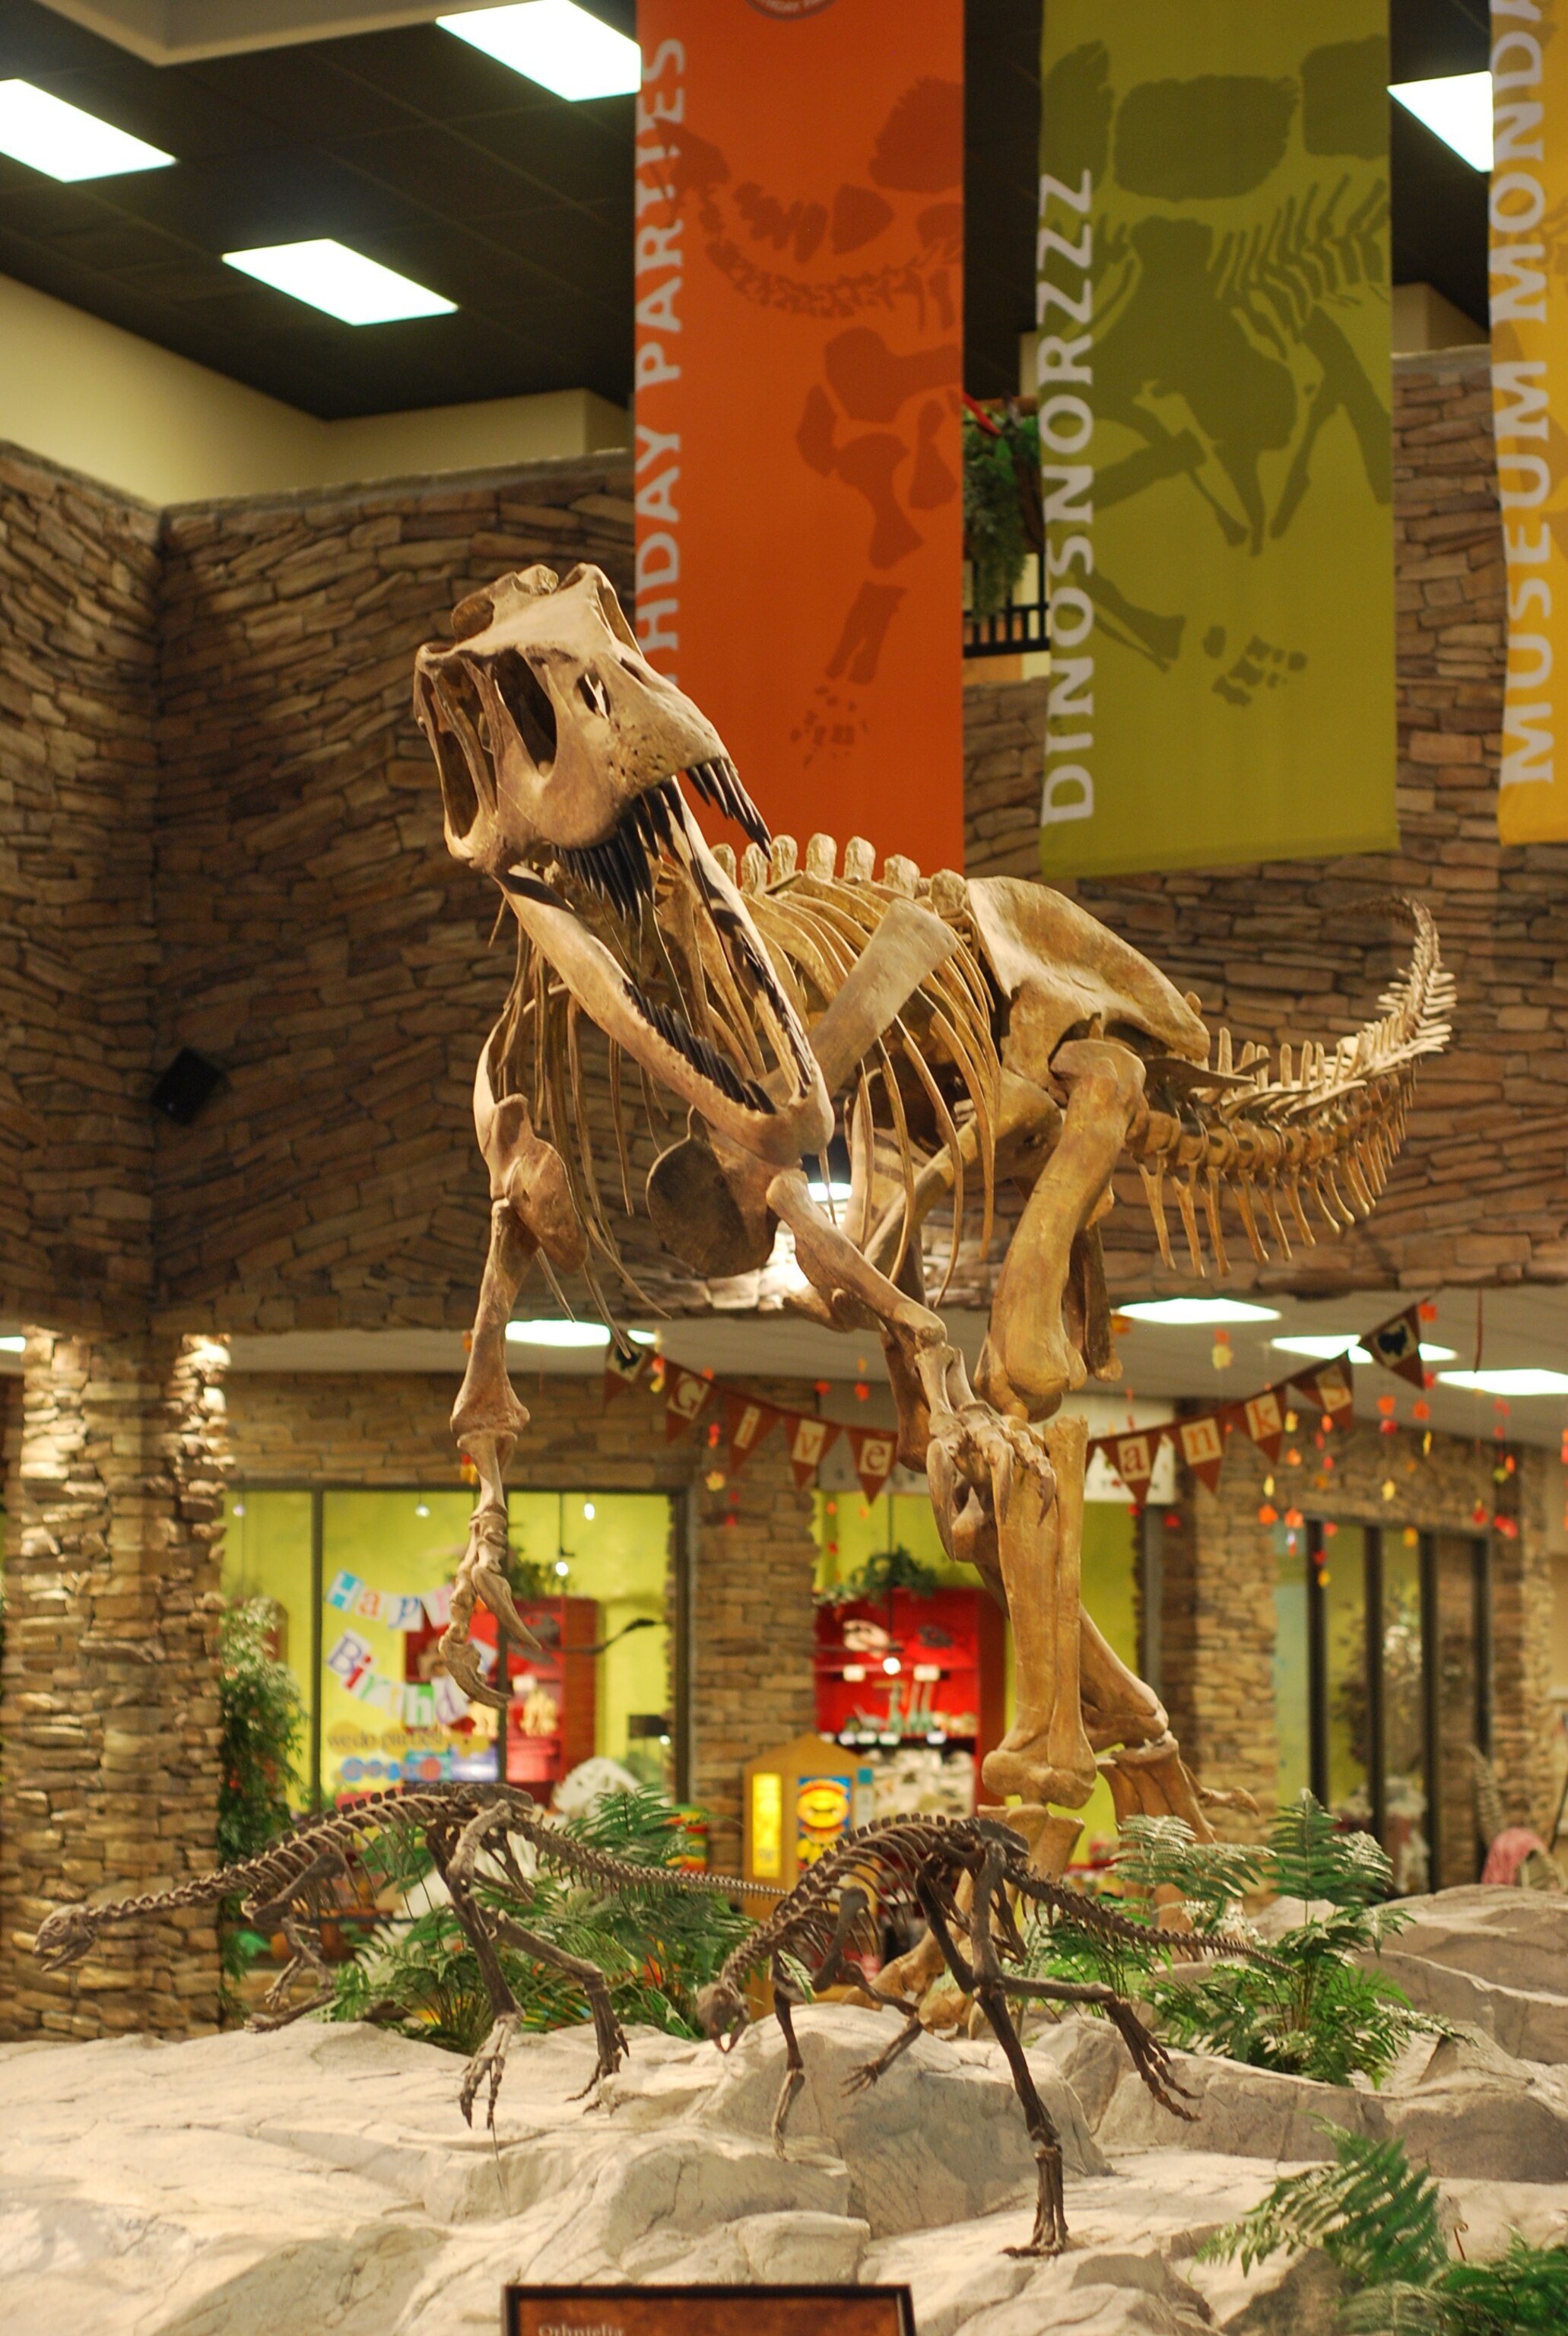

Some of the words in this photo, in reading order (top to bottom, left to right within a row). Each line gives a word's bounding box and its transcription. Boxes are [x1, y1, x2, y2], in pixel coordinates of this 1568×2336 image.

[635, 38, 685, 392] PARTIES
[636, 424, 679, 684] HDAY
[1036, 169, 1095, 827] DINOSNORZZZ
[1493, 360, 1554, 785] MUSEUM
[1123, 1371, 1348, 1474] anks
